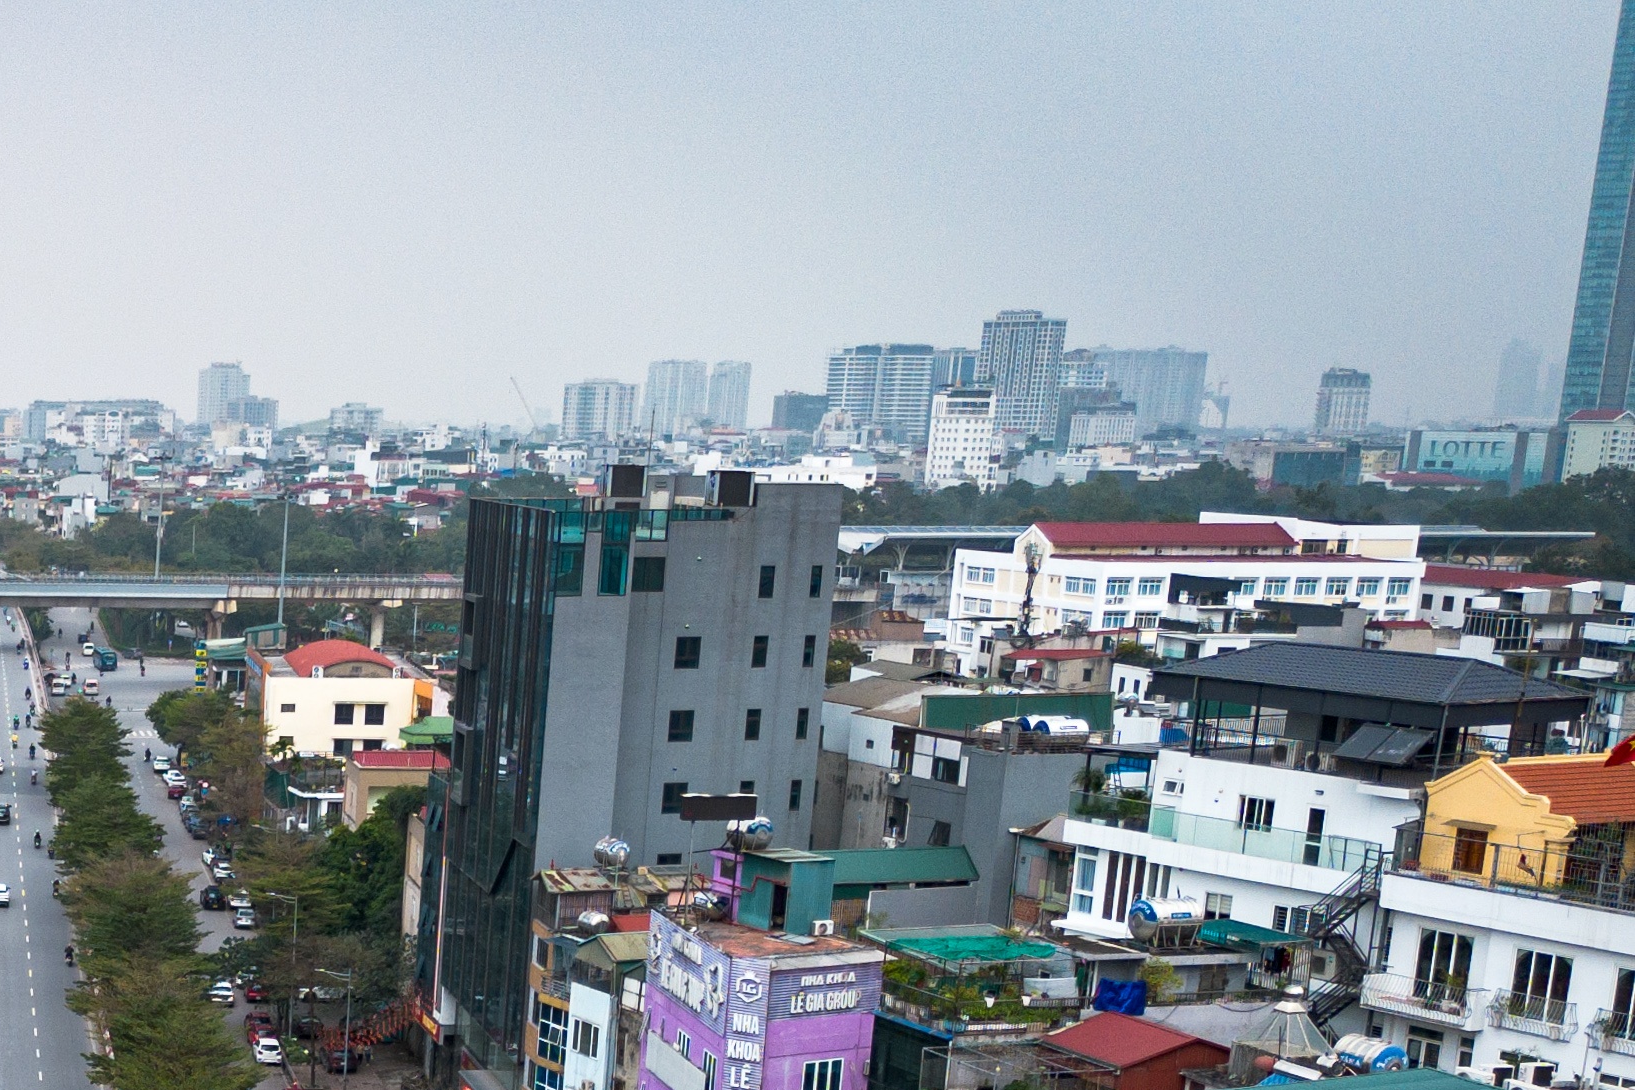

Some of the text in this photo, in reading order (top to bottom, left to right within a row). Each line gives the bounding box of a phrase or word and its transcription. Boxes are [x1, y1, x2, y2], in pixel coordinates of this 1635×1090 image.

[1430, 440, 1506, 458] LOTTE
[790, 988, 862, 1014] LÊ GIA GROUP
[732, 1012, 759, 1035] NHA
[727, 1038, 760, 1062] KHOA
[730, 1063, 752, 1090] LÊ
